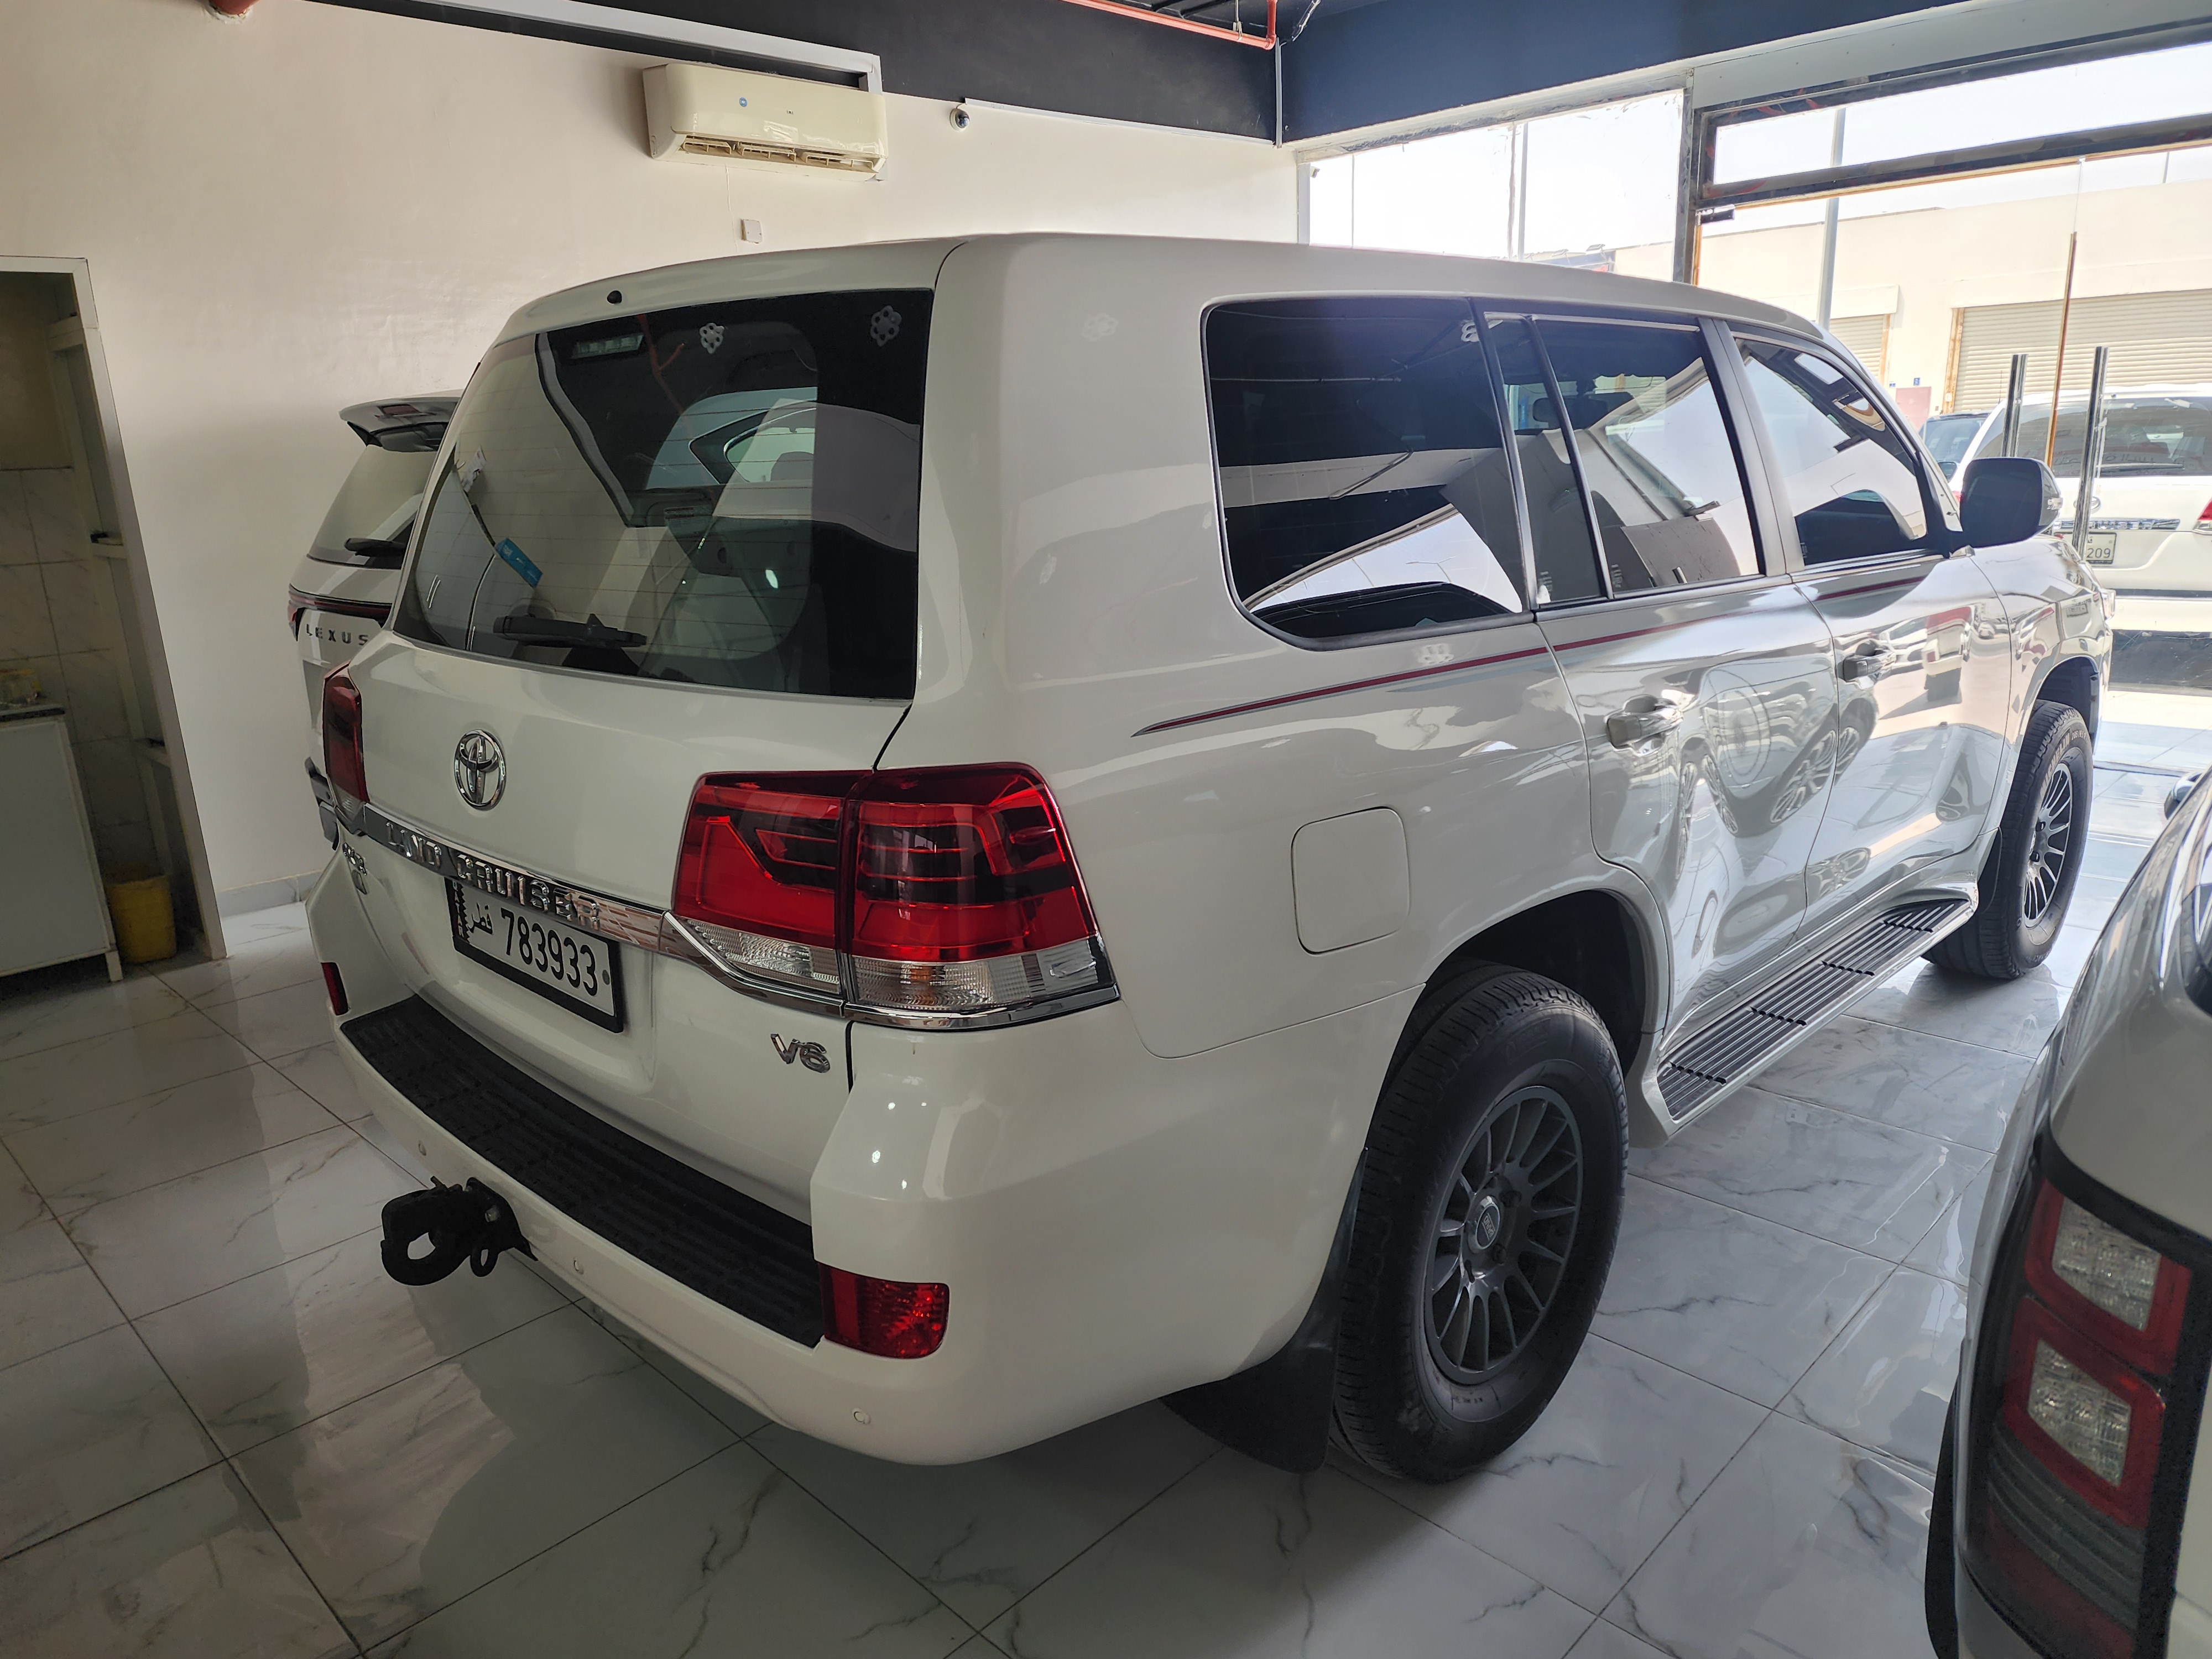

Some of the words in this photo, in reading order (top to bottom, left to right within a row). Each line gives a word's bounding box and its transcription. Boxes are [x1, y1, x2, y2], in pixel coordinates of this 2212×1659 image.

[305, 623, 369, 646] LEXUS
[385, 821, 442, 868] LAND
[456, 852, 601, 930] CRUISER
[466, 902, 493, 935] قطر
[500, 907, 599, 997] 783933
[770, 1032, 831, 1073] V6
